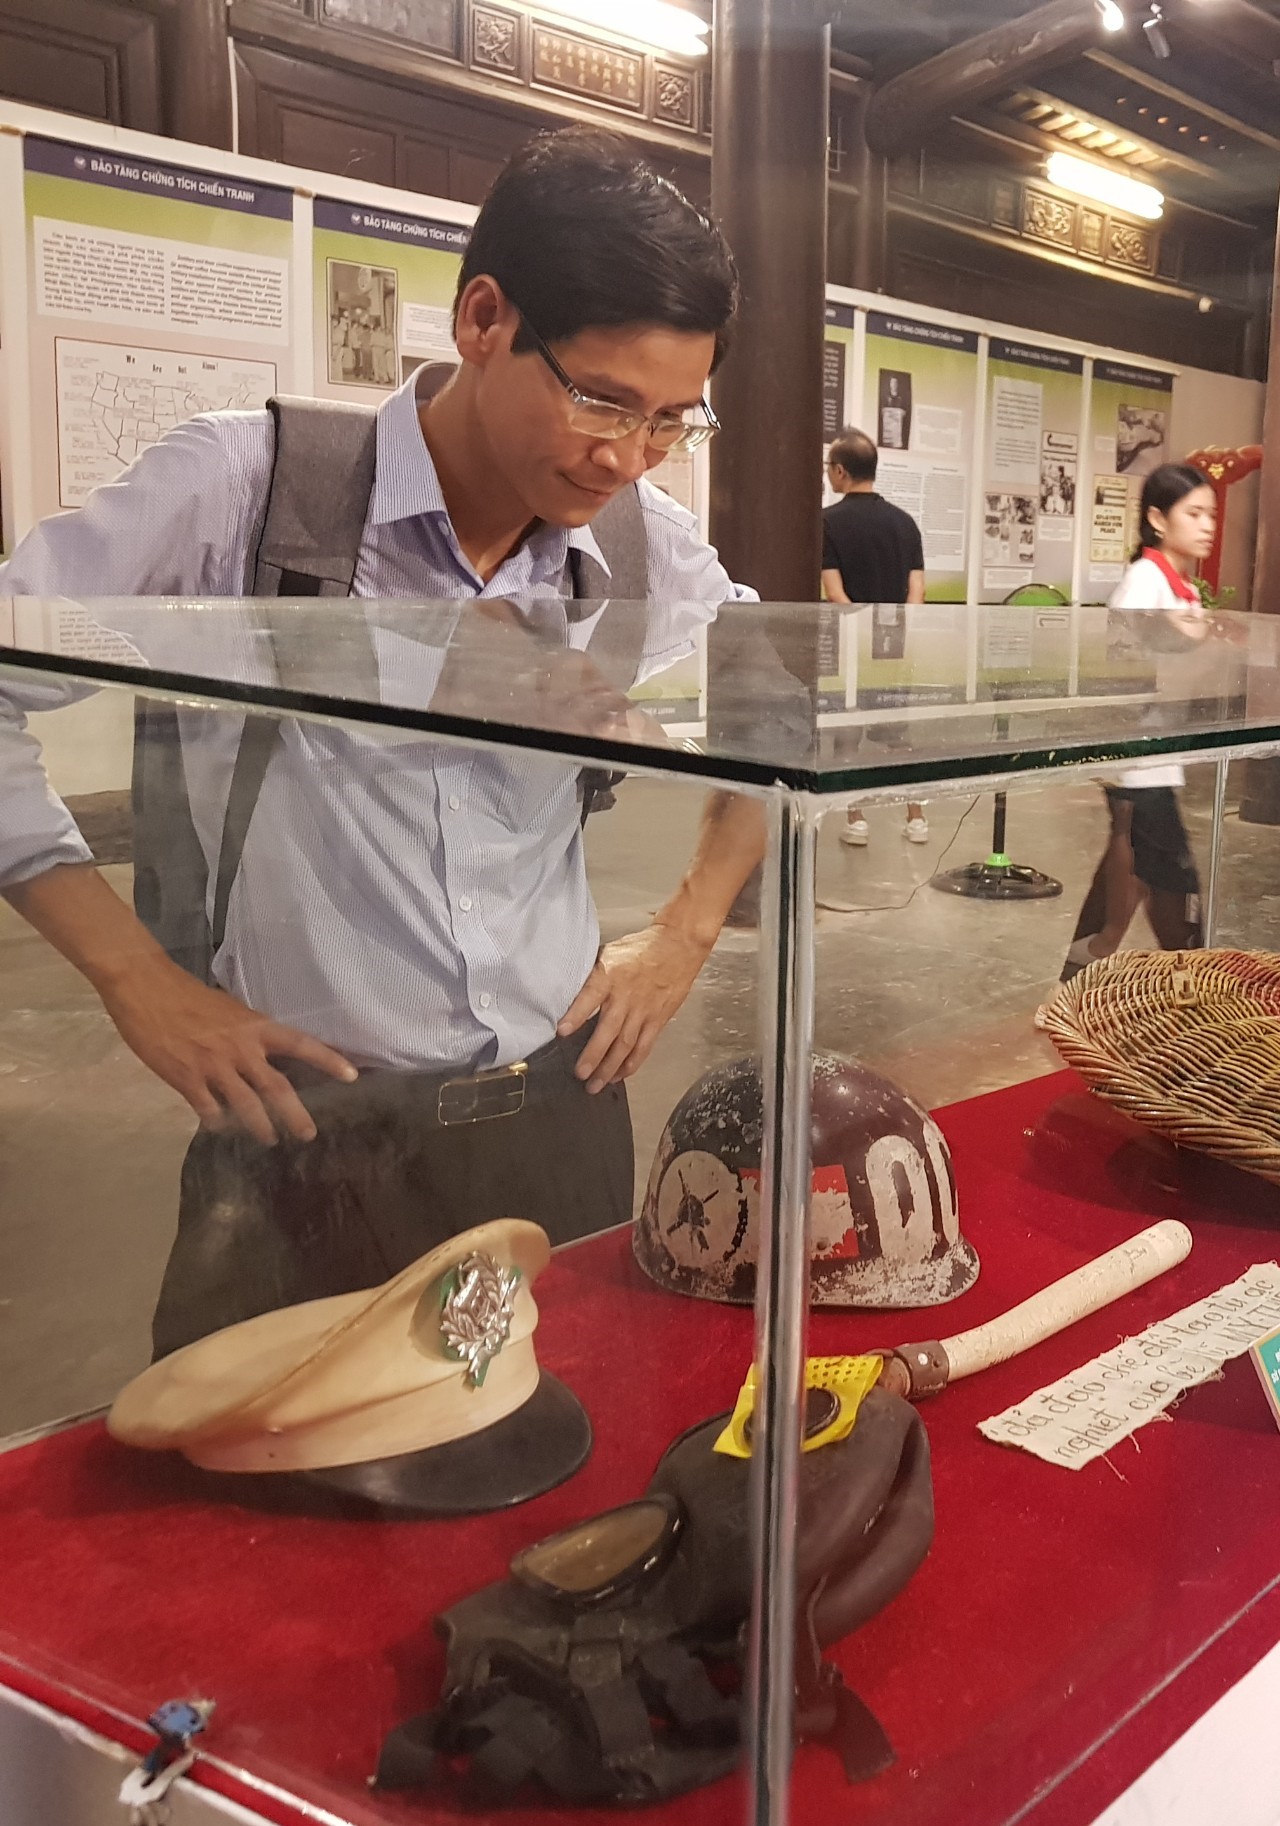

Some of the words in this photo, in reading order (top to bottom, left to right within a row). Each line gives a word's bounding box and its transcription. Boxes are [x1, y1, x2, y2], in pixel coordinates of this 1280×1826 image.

[91, 158, 112, 174] BẢO
[114, 164, 140, 180] TÀNG
[141, 170, 175, 187] CHỨNG
[176, 176, 197, 193] TÍCH
[225, 187, 255, 203] TRANH
